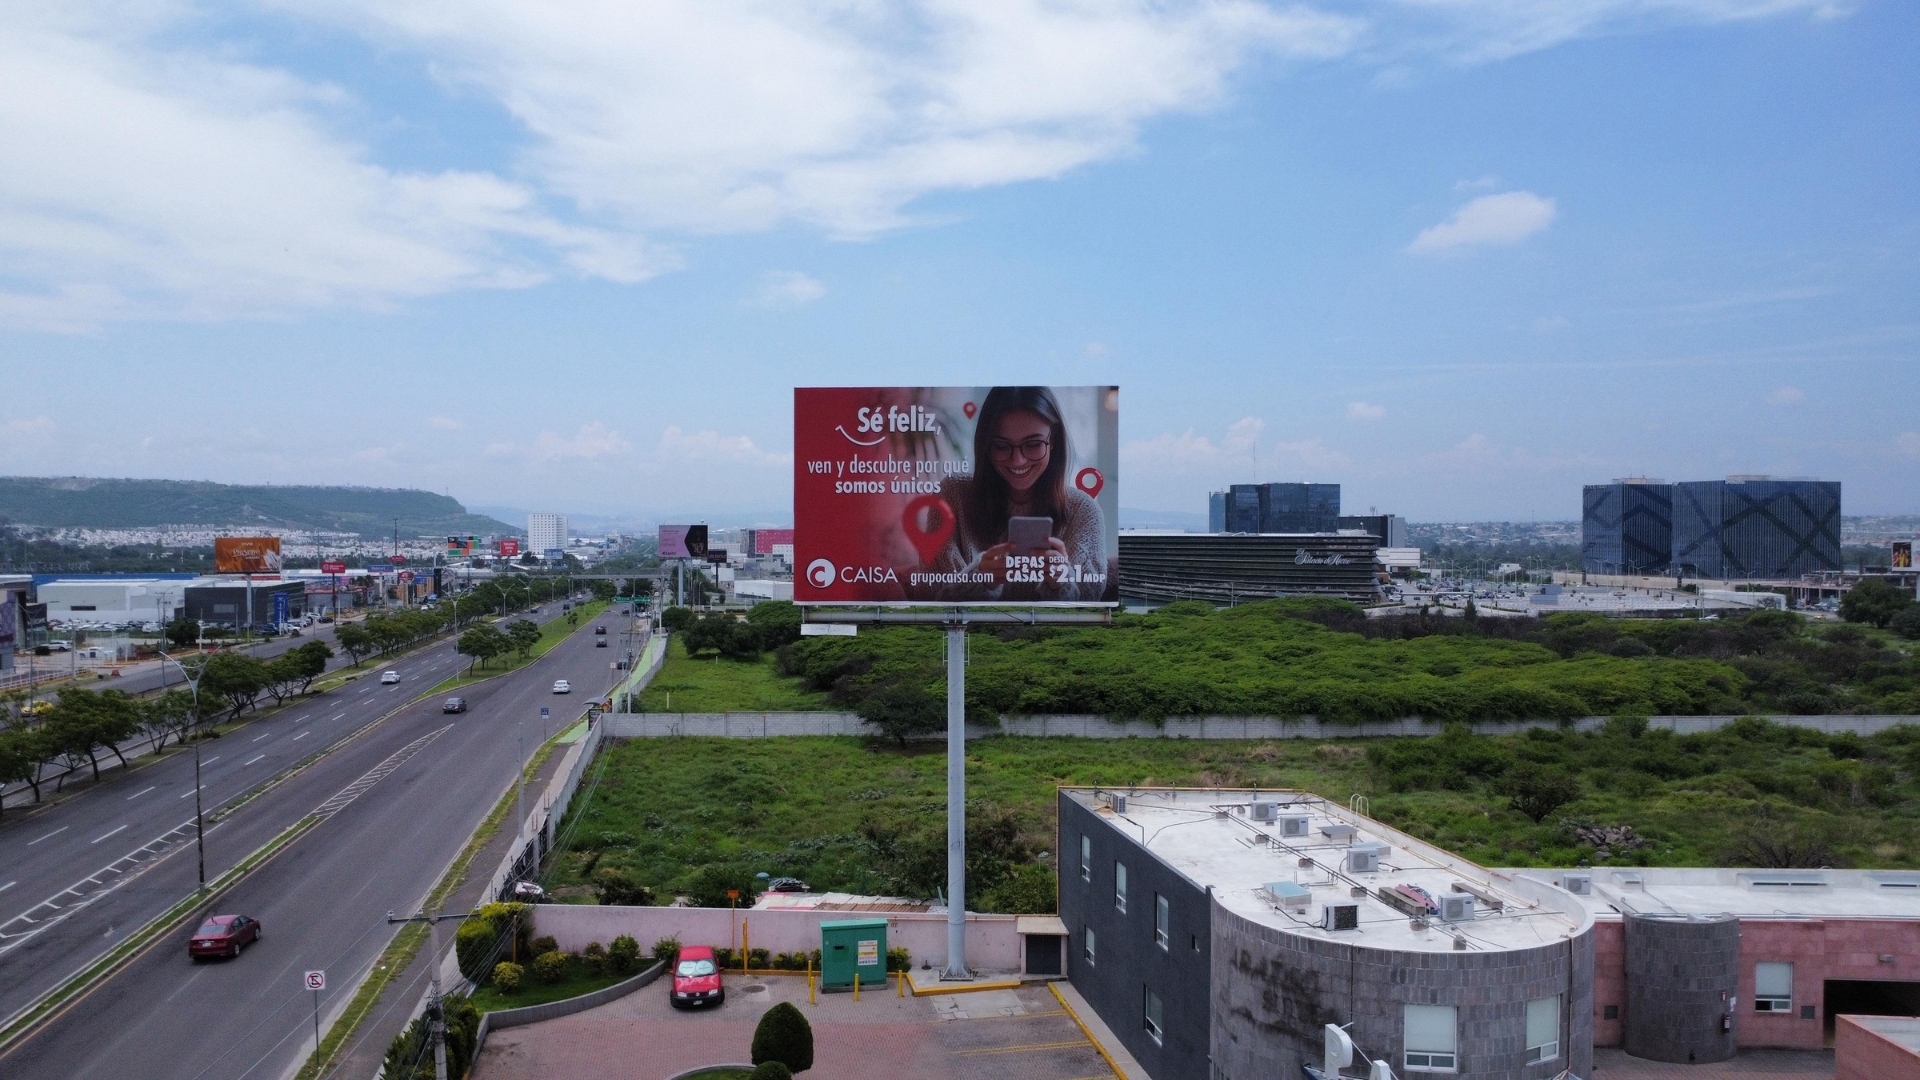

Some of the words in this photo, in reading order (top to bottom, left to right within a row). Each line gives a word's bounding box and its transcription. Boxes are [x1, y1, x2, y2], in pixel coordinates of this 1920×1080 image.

[857, 406, 884, 433] Sé
[887, 405, 942, 436] feliz,
[807, 460, 832, 474] ven
[836, 460, 846, 477] y
[849, 454, 911, 474] descubre
[915, 460, 939, 477] por
[942, 456, 970, 477] qué
[835, 479, 886, 494] somos
[890, 476, 942, 494] únicos
[1006, 555, 1045, 568] DEPAS
[840, 566, 899, 584] CAISA
[910, 571, 994, 587] grupocaisa.com
[1006, 570, 1045, 583] CASAS
[1083, 573, 1106, 583] MDP
[1021, 563, 1030, 574] &
[1049, 564, 1082, 583] $2.1
